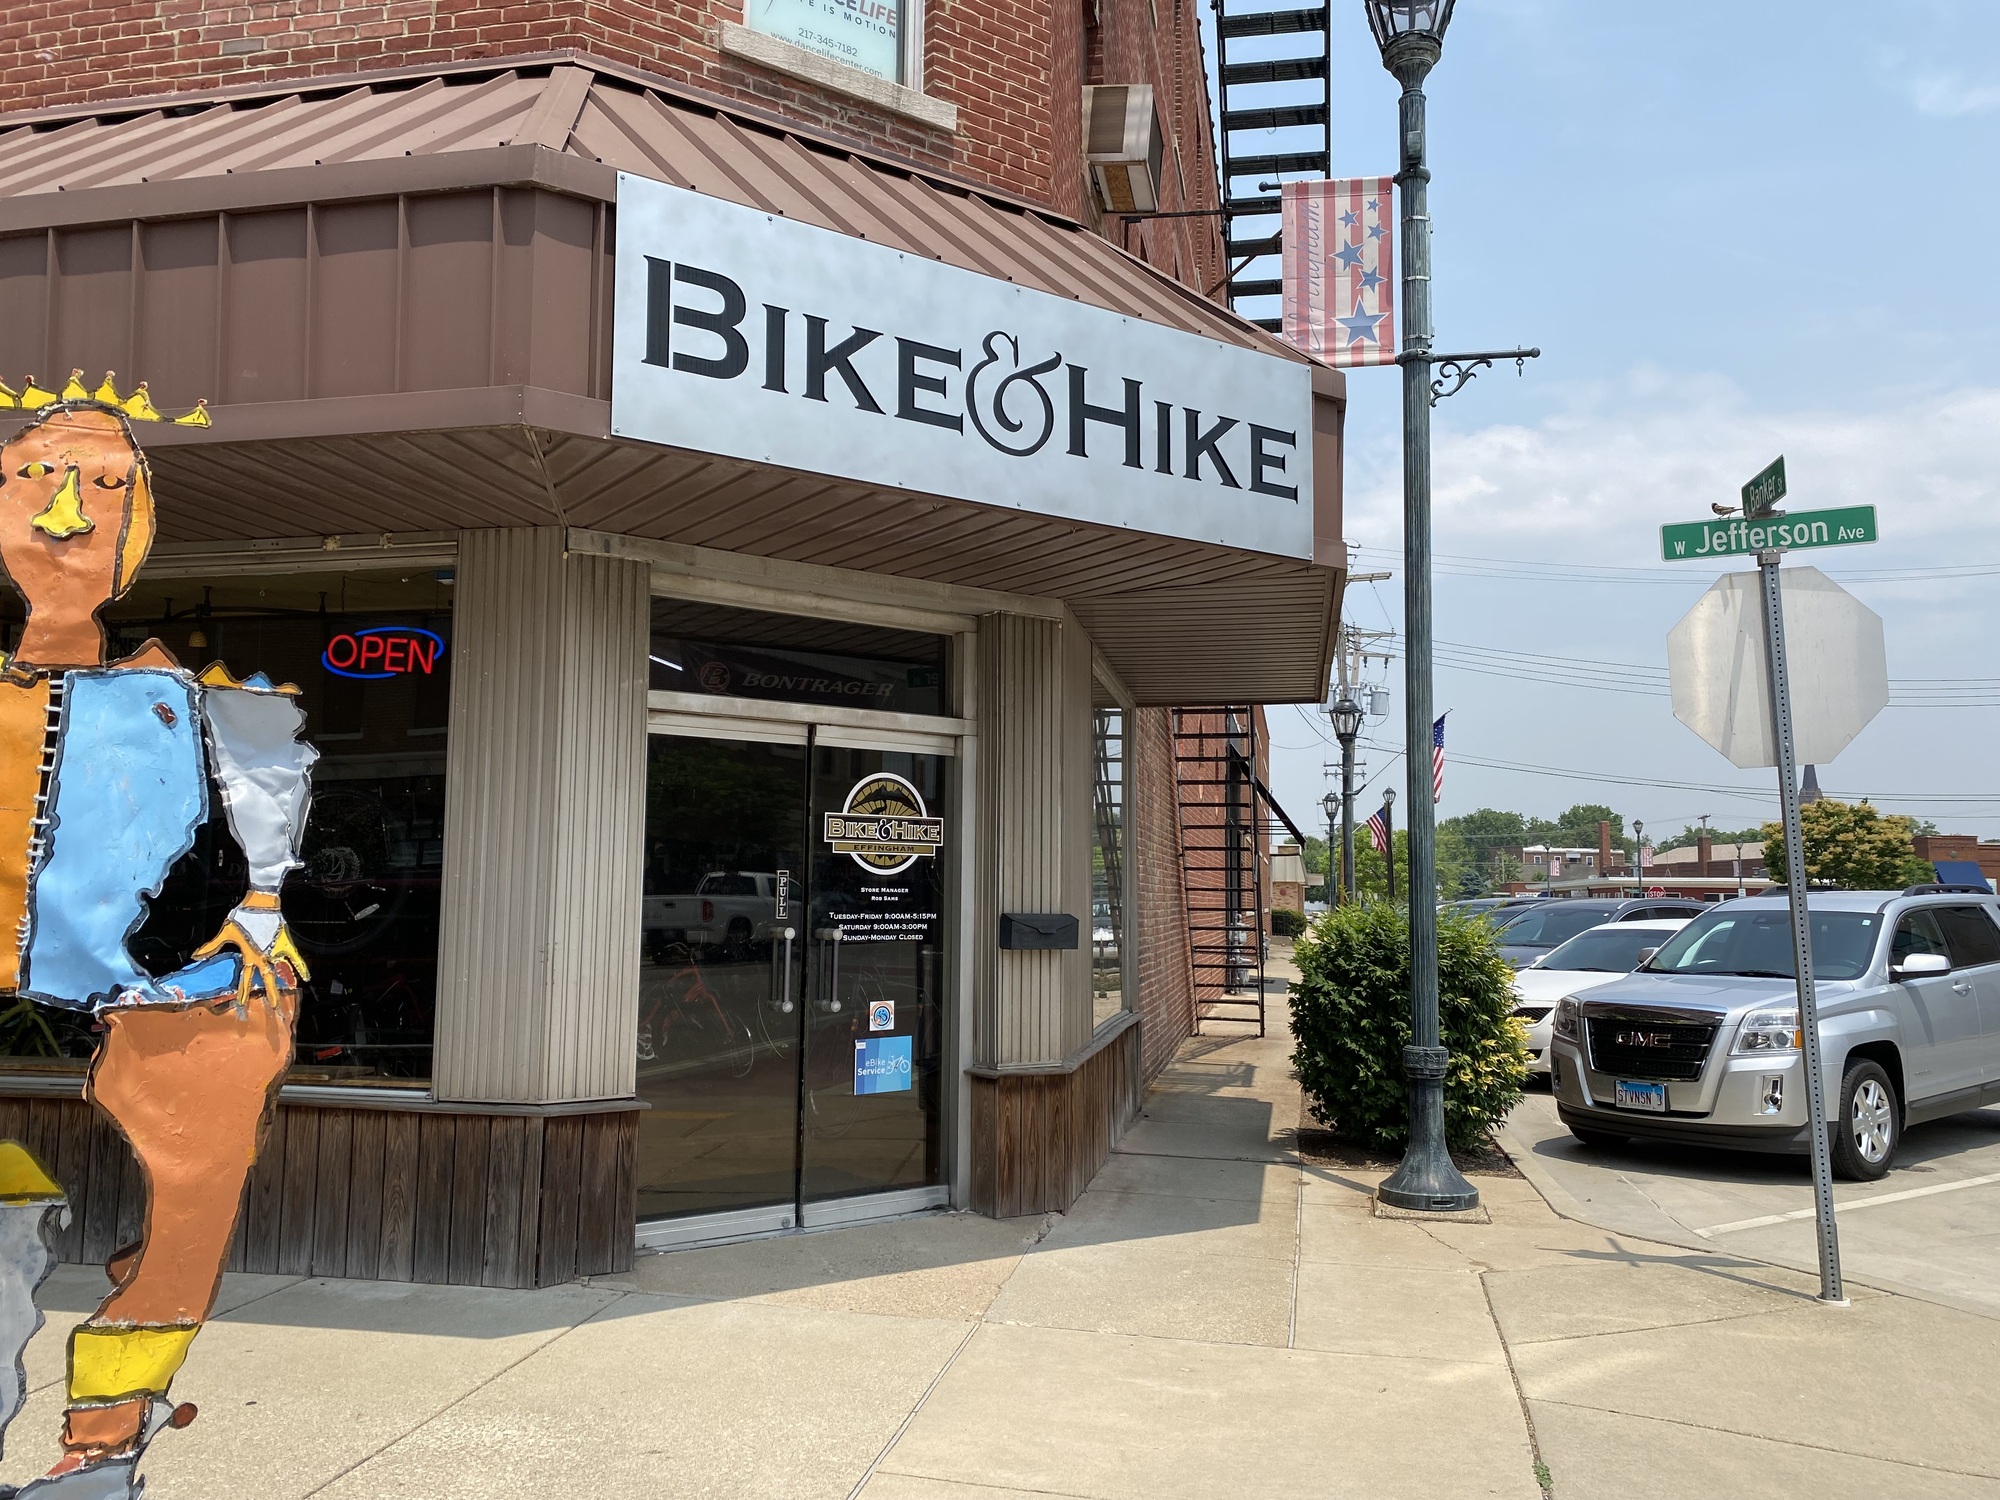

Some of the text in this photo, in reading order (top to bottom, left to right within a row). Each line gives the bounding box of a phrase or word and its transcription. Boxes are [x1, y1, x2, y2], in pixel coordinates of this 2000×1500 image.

[823, 4, 896, 39] IS MOTION
[770, 31, 883, 78] www.dancelifecenter.com
[798, 27, 858, 57] 217-345-7182
[1749, 474, 1776, 512] Banker
[1674, 521, 1865, 555] W Jefferson Ave
[328, 634, 435, 674] OPEN
[742, 672, 895, 697] BONTRAGER
[853, 844, 915, 852] EFFINGHAM
[779, 876, 787, 917] PULL
[829, 912, 883, 920] TUESDAY-FRIDAY
[898, 933, 924, 941] CLOSED
[1616, 1031, 1671, 1048] GMC
[857, 1067, 886, 1076] Service
[865, 1058, 886, 1067] eBike
[1618, 1089, 1652, 1105] STVNSN
